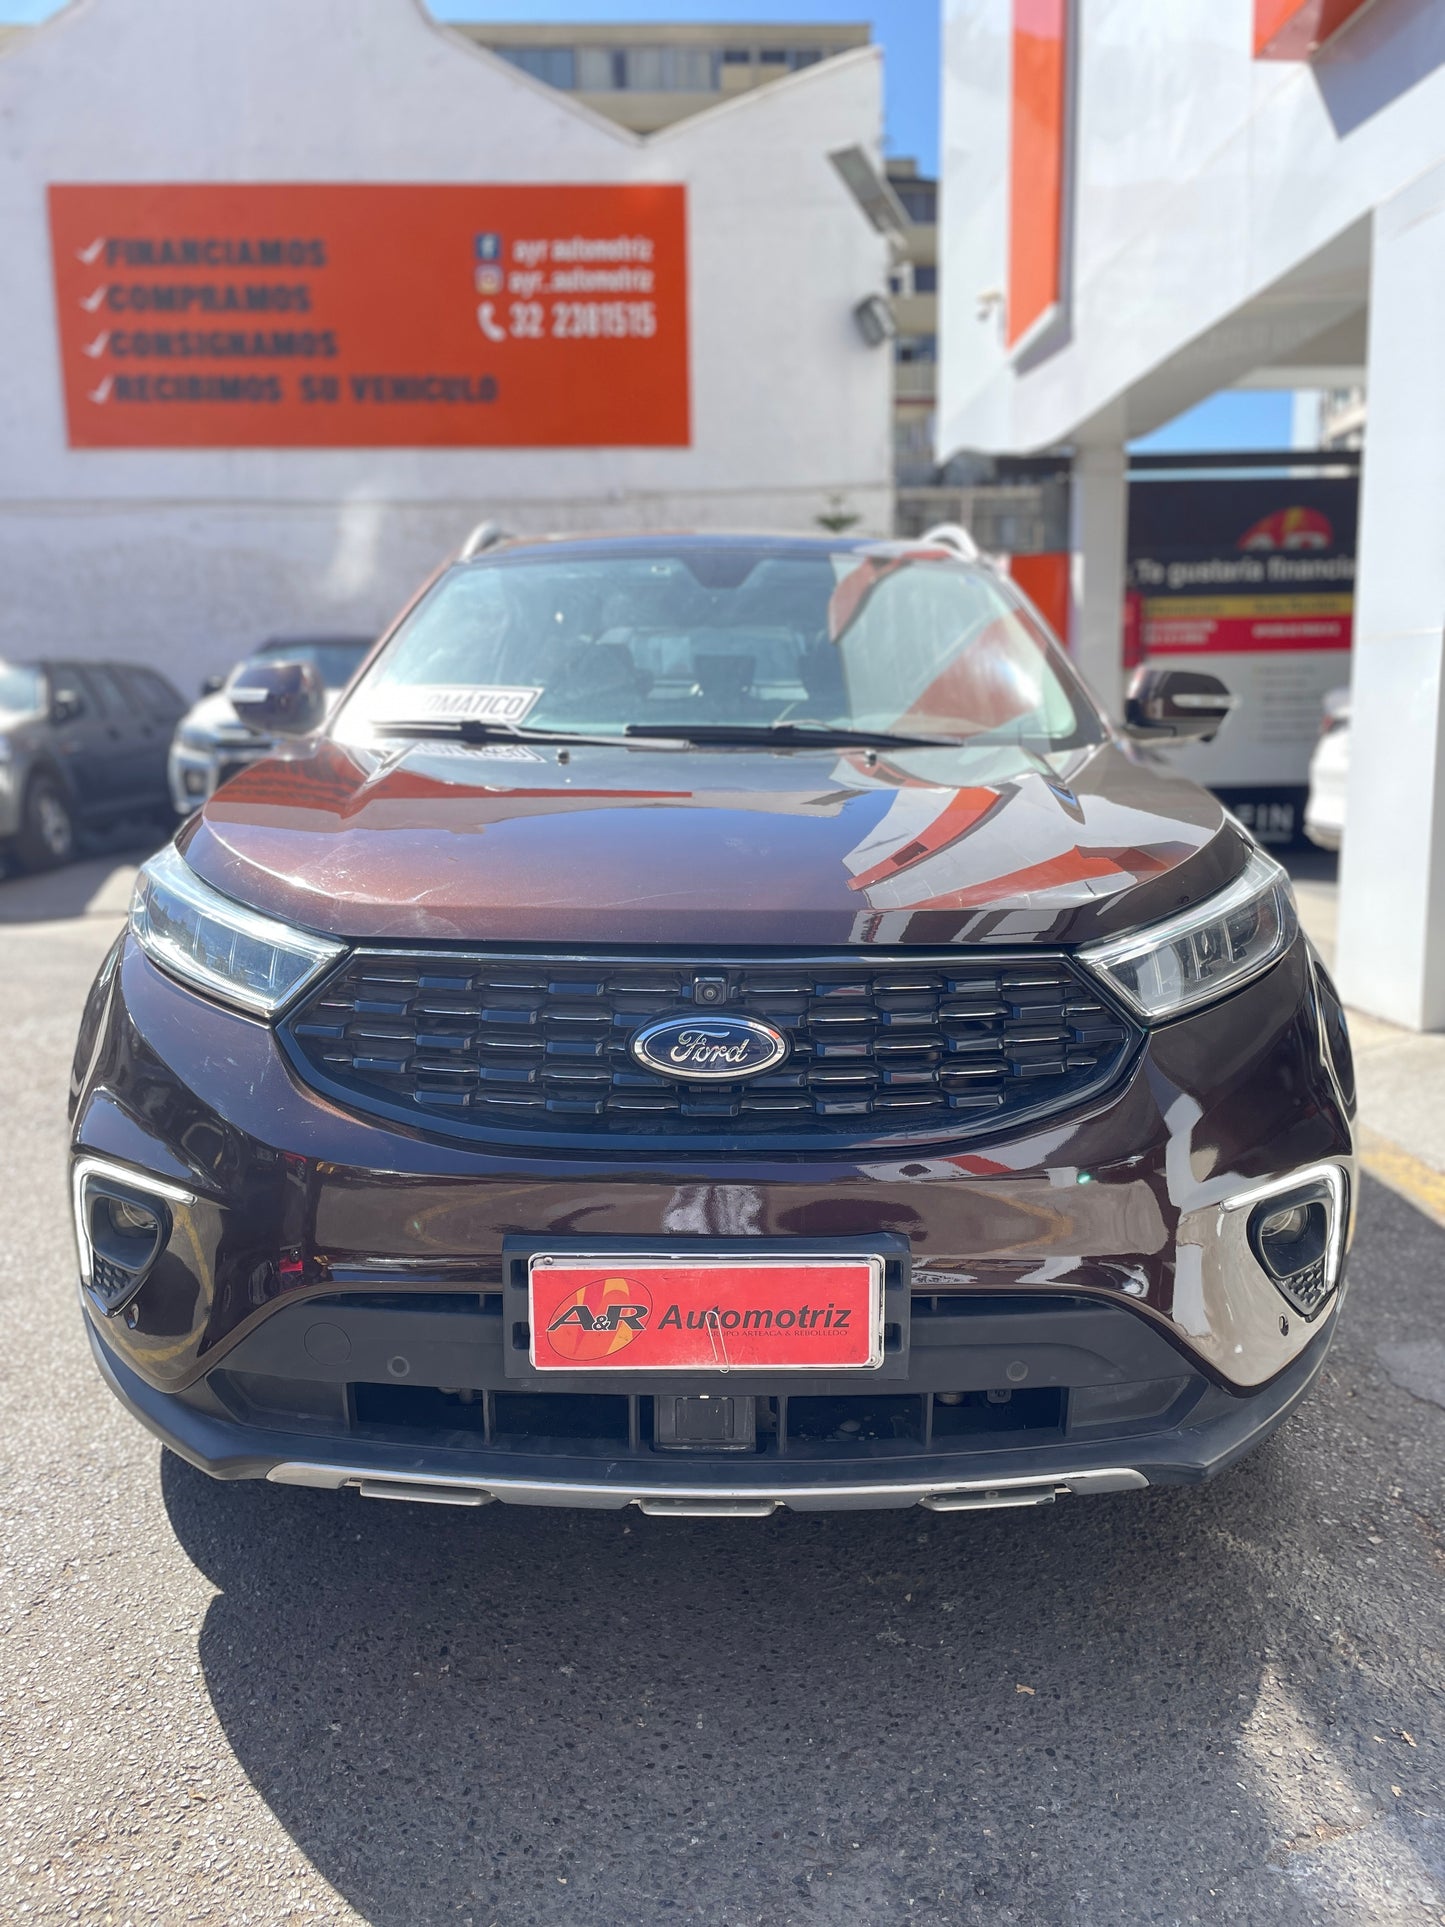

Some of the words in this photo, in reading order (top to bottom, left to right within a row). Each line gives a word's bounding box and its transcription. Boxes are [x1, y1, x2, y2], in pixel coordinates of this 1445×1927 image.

[106, 237, 327, 267] FINANCIAMOS
[551, 234, 655, 264] automotriz
[108, 284, 312, 314] COMPRAMOS
[110, 330, 338, 359] CONSIGNAMOS
[115, 374, 283, 404] RECIBIMOS
[301, 375, 341, 403] SU
[424, 692, 525, 716] OMÁTICO
[670, 1029, 750, 1063] Ford
[546, 1304, 649, 1332] A&R
[657, 1303, 852, 1330] Automotriz
